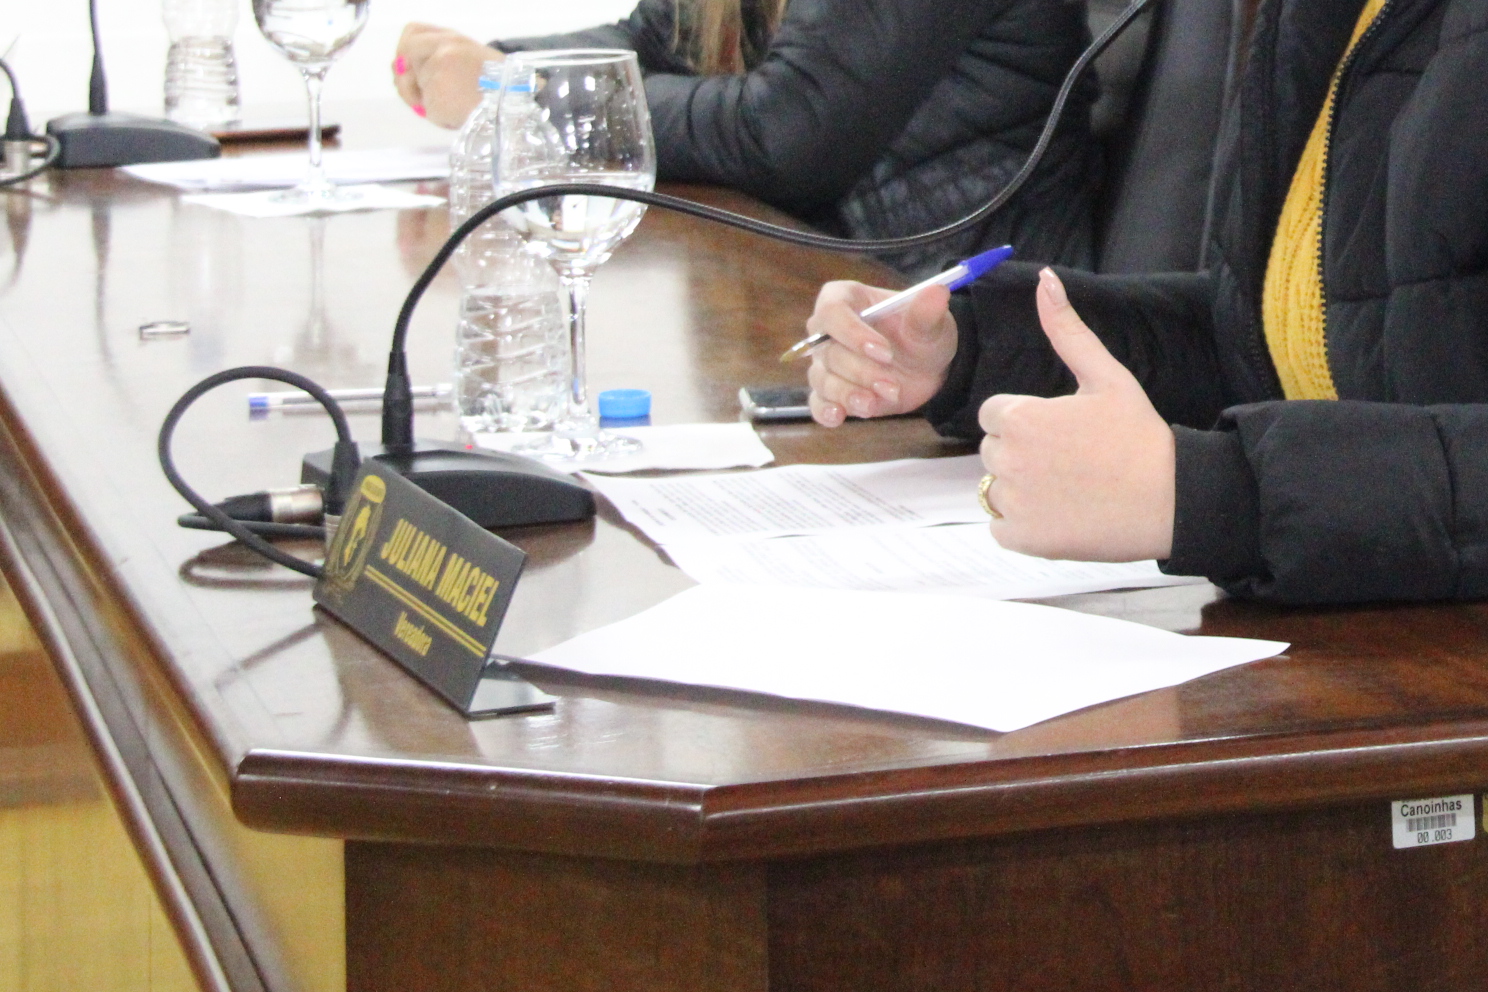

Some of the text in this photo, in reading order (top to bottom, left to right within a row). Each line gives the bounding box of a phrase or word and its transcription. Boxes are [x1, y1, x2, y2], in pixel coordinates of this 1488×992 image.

[380, 518, 500, 628] JULIANA MACIEL
[393, 610, 433, 657] Vereadora
[1401, 798, 1462, 817] Canoinhas
